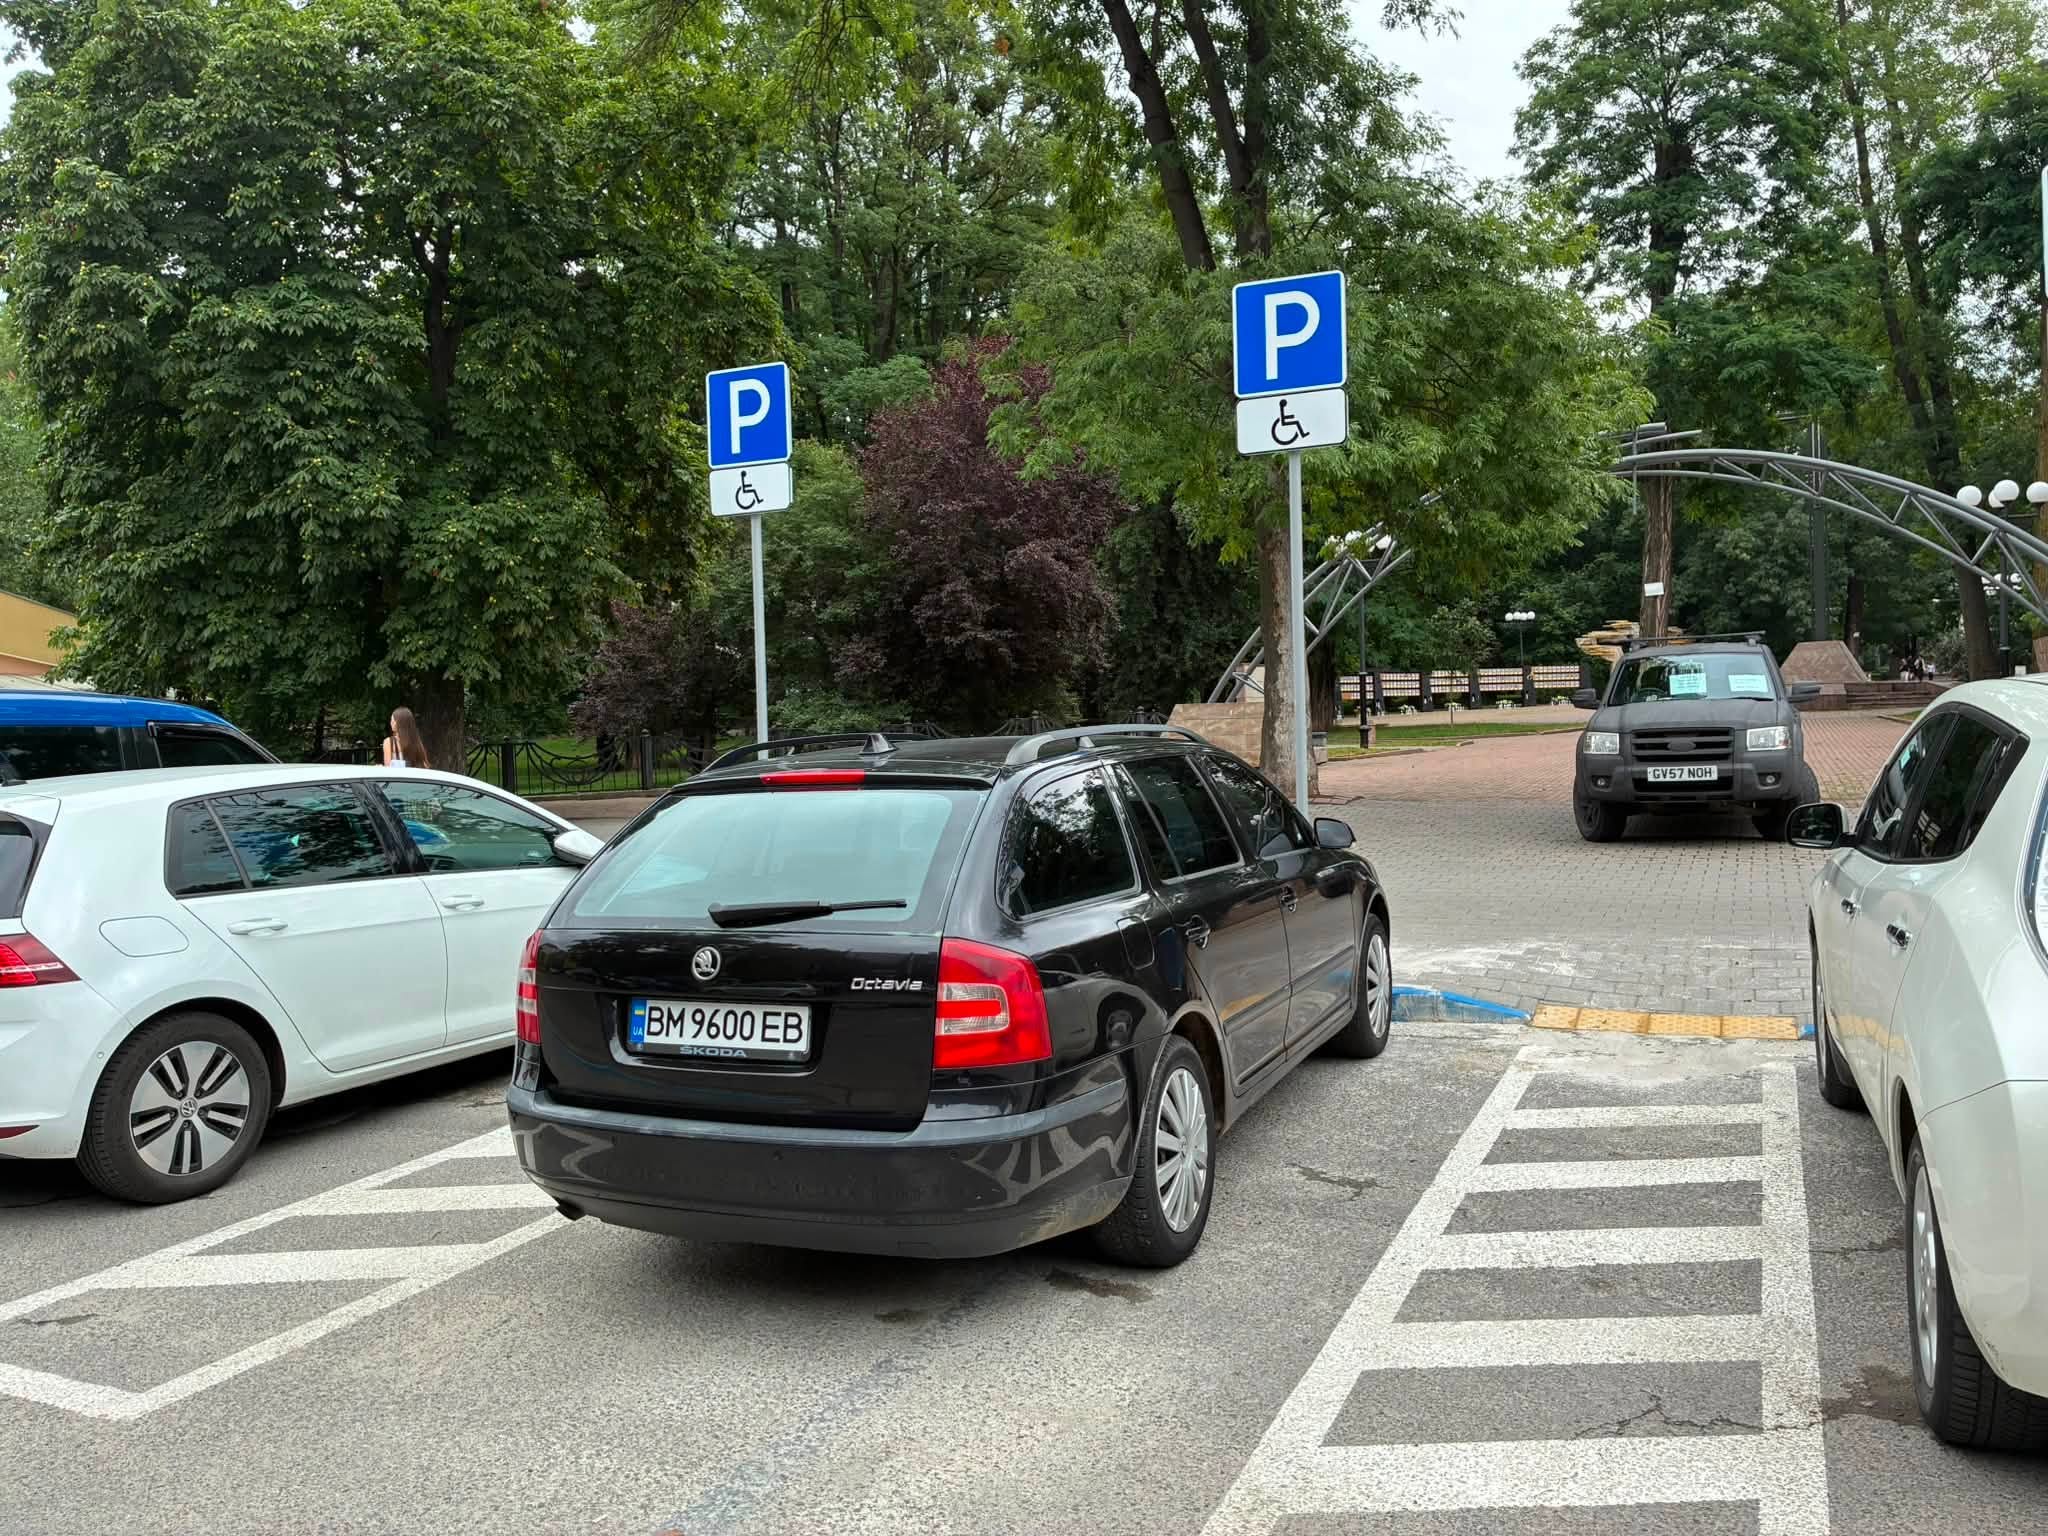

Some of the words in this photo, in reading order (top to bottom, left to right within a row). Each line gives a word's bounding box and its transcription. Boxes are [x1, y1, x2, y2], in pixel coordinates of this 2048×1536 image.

[1265, 291, 1320, 381] P
[729, 378, 770, 455] P
[1653, 768, 1684, 779] GV57
[1688, 767, 1712, 778] NOH
[850, 977, 923, 991] Octavia
[632, 1027, 643, 1036] UA
